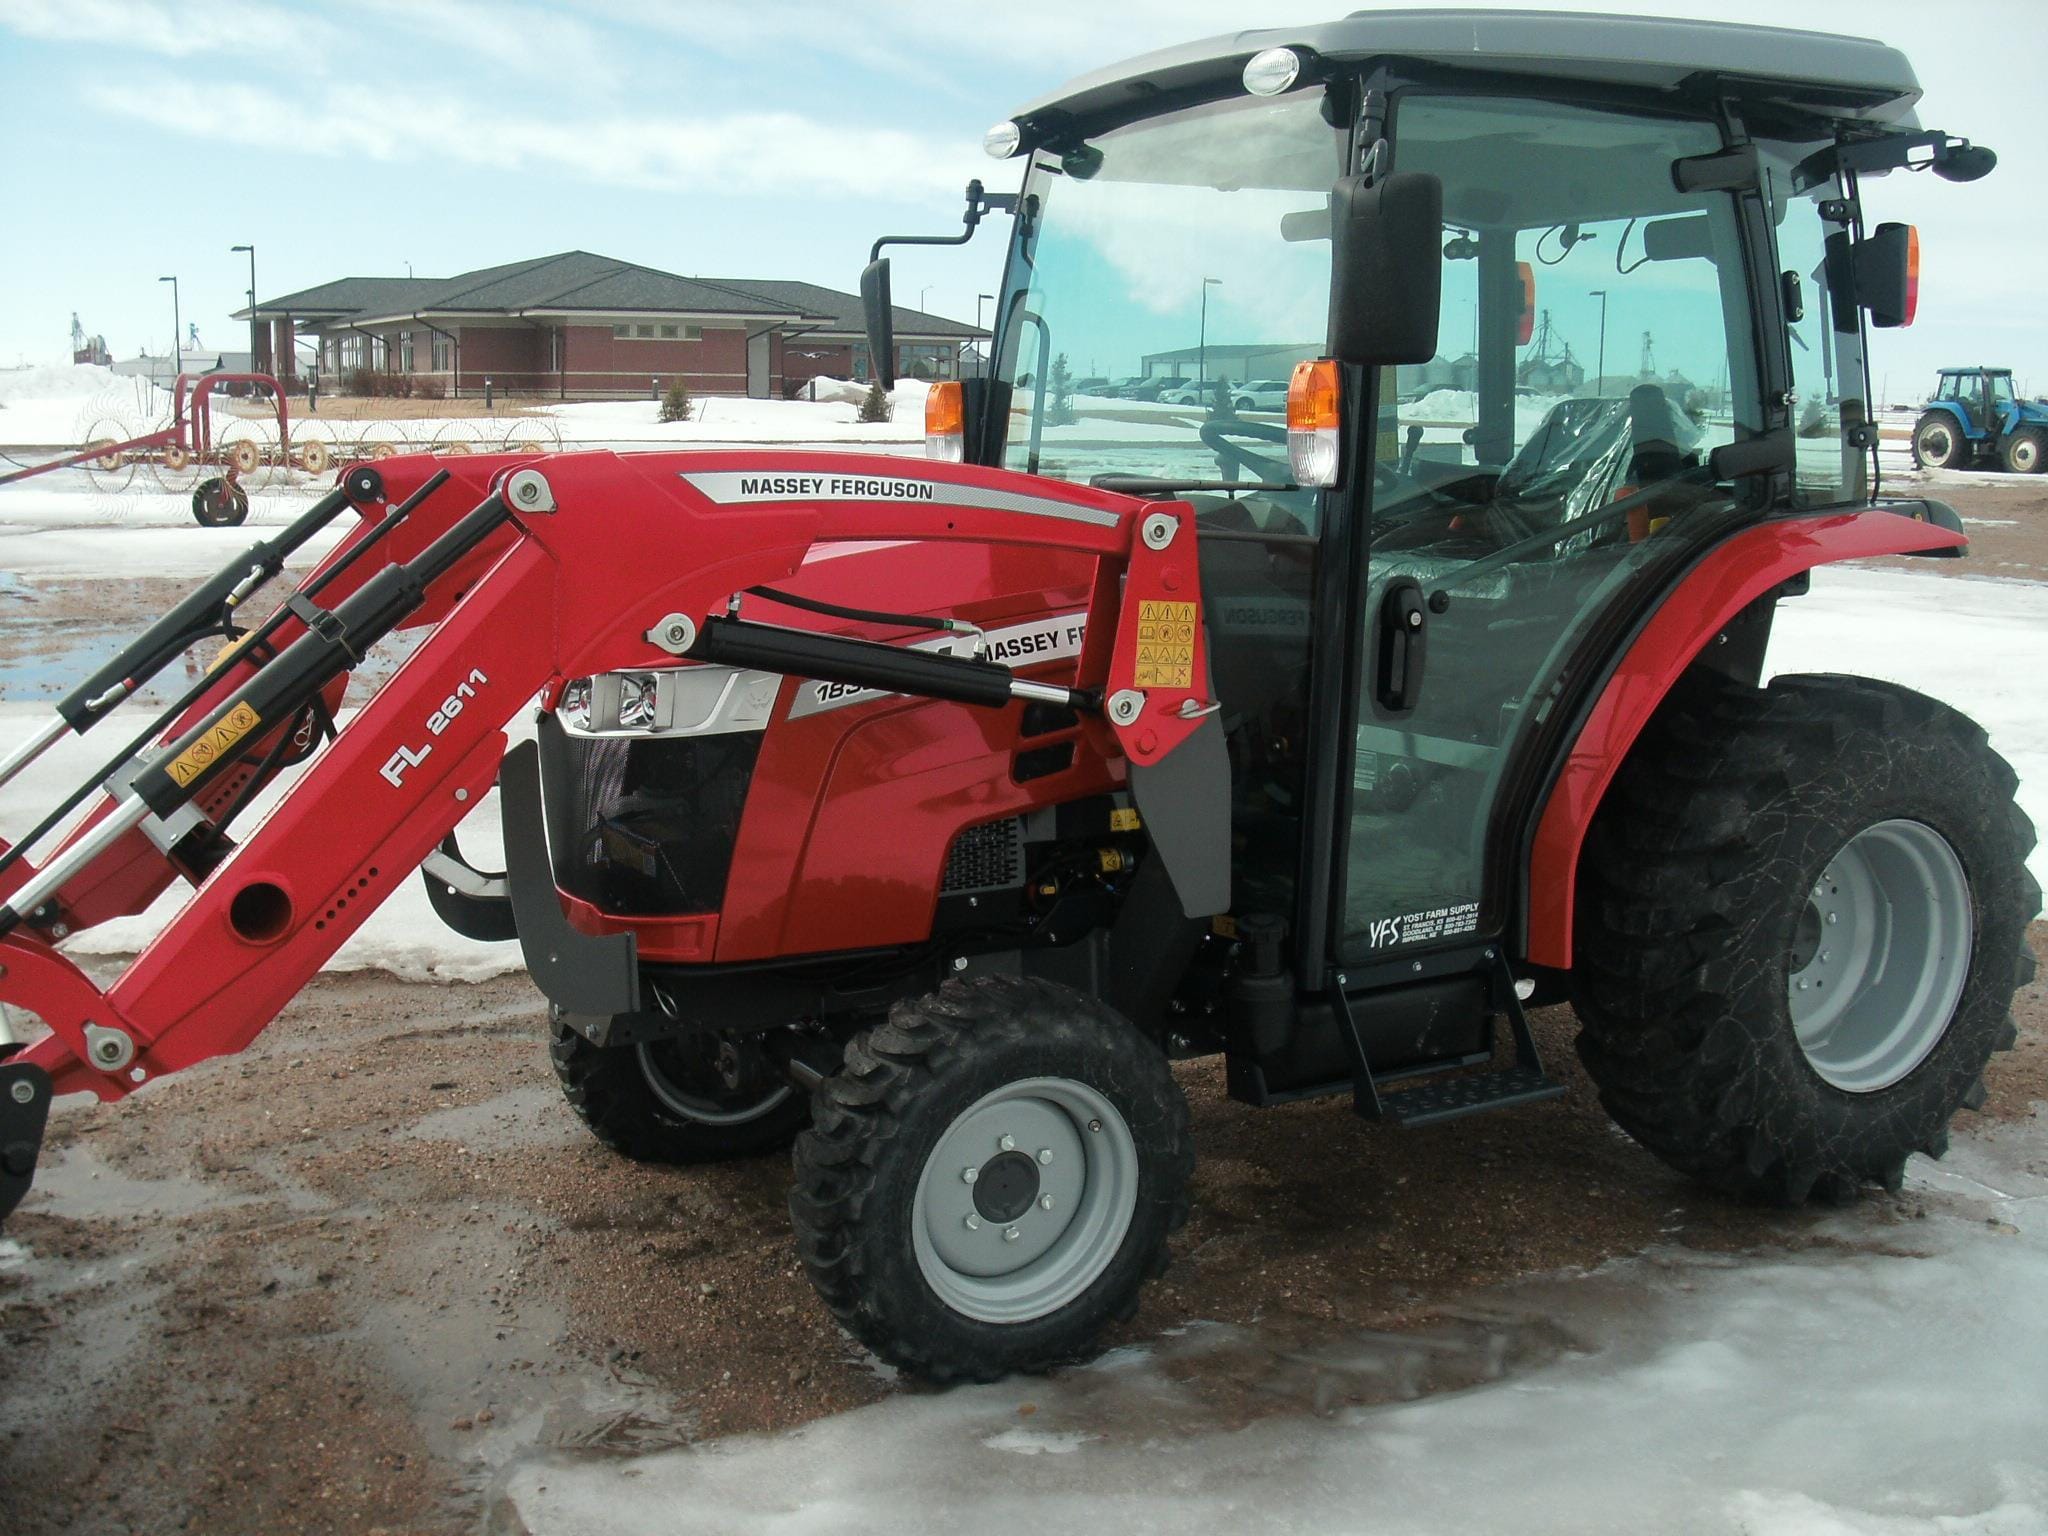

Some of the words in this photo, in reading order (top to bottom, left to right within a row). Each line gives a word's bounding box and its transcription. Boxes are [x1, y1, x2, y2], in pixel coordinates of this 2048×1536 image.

[741, 478, 823, 496] MASSEY
[831, 478, 933, 500] FERGUSON
[379, 743, 433, 788] FL
[425, 668, 488, 736] 2611
[1403, 912, 1425, 924] YOST
[1426, 908, 1448, 920] FARM
[1449, 902, 1479, 916] SUPPLY
[1370, 916, 1402, 949] YFS
